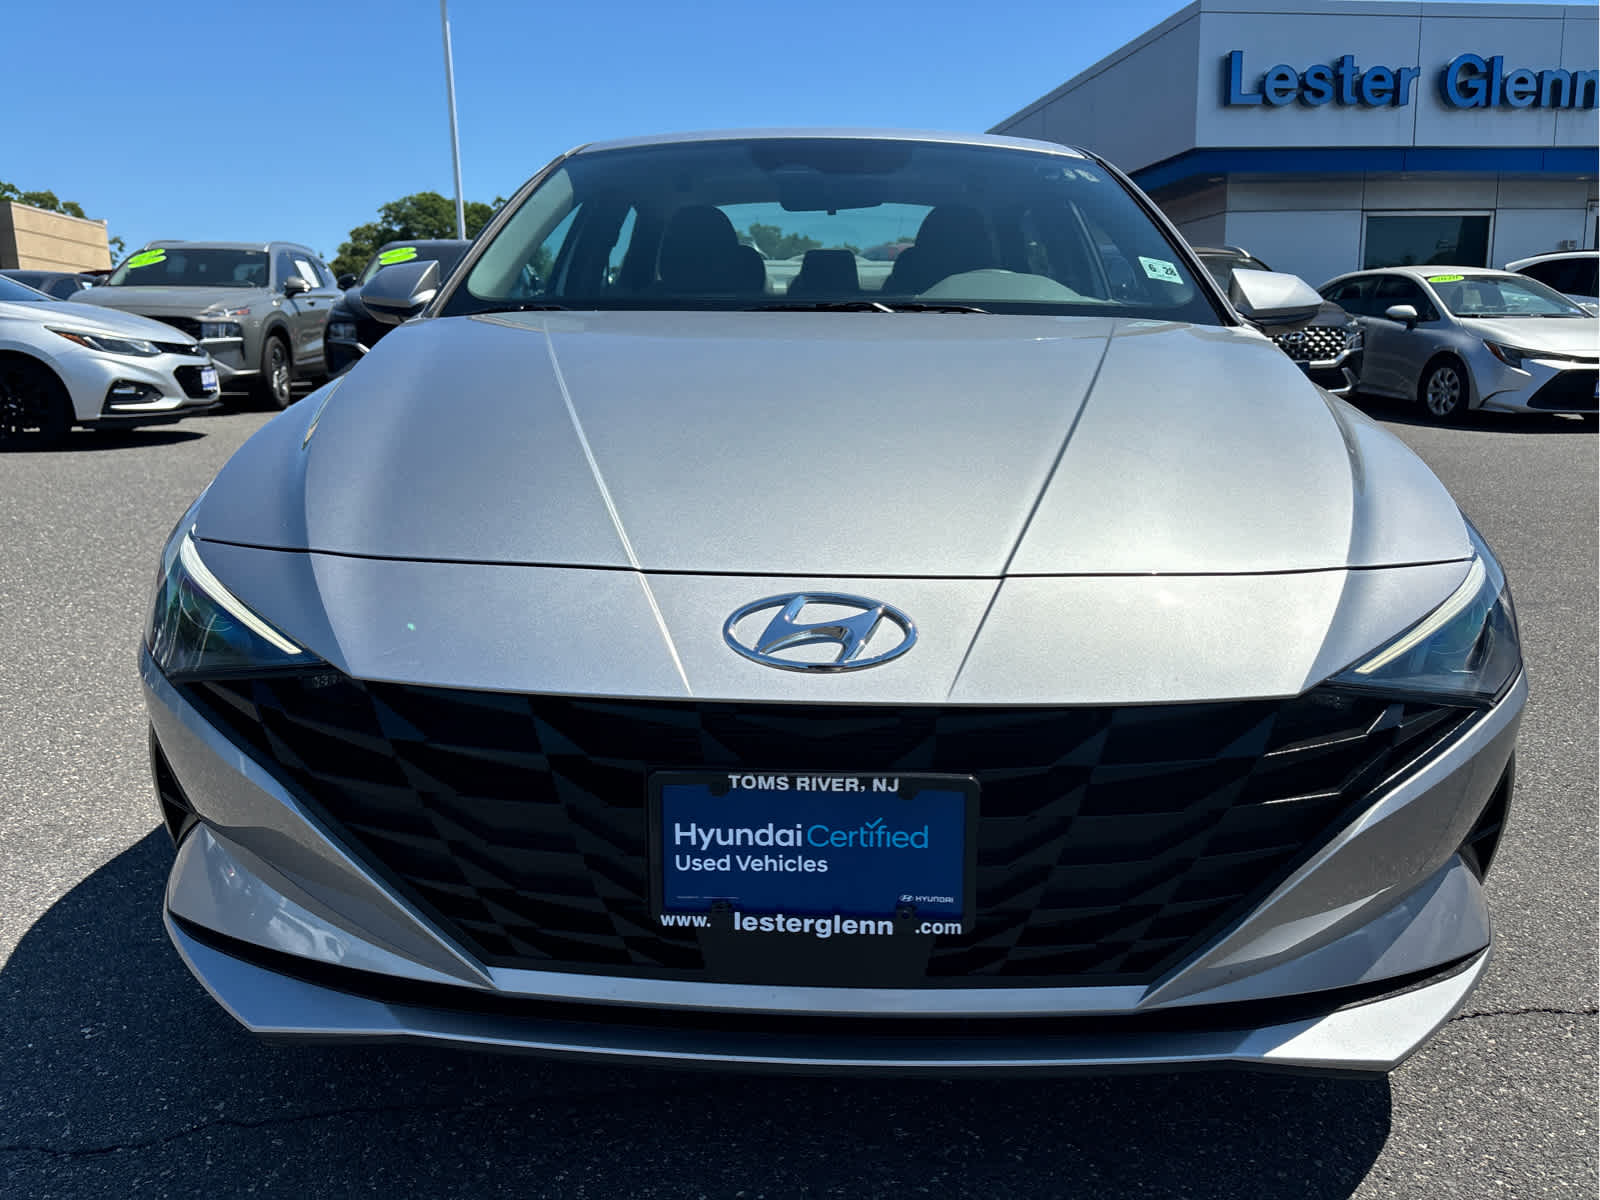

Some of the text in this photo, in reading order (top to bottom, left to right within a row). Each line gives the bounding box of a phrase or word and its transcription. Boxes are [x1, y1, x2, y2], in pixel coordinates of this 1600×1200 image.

[1225, 50, 1599, 109] Lester Glenn
[727, 774, 900, 793] TOMS RIVER, NJ
[674, 818, 929, 851] Hyundai Certified
[675, 854, 829, 873] Used Vehicles
[915, 895, 955, 903] HYUNDAI
[660, 911, 962, 939] www. lesterglenn .com
